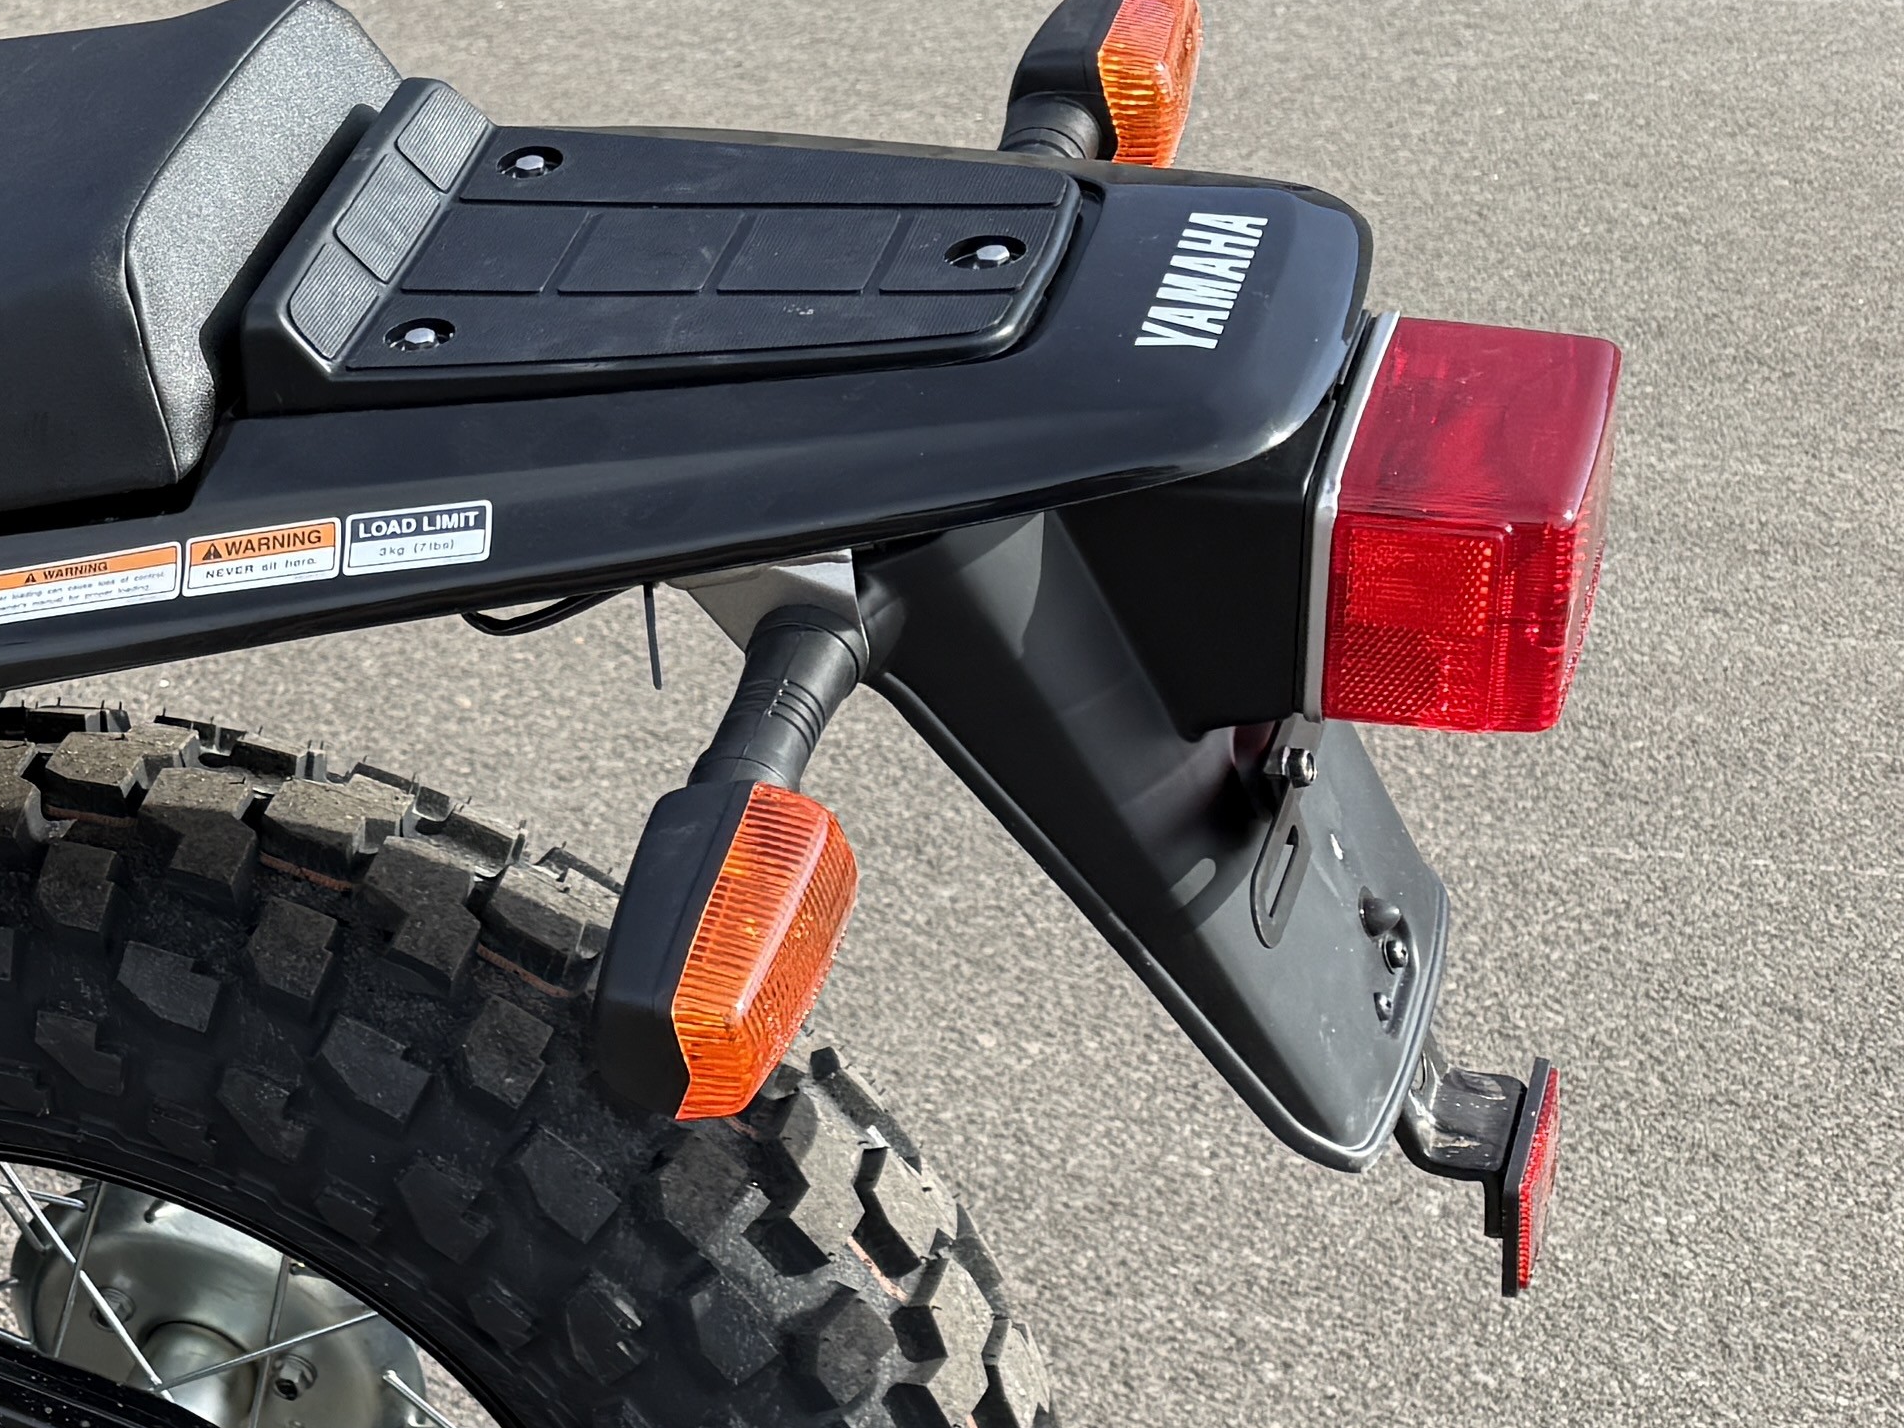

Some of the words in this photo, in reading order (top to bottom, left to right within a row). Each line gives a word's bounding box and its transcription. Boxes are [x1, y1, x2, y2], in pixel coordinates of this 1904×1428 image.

[1134, 212, 1269, 350] YAMAHA
[358, 518, 417, 539] LOAD
[422, 511, 479, 532] LIMIT
[225, 529, 322, 557] WARNING
[42, 561, 108, 581] WARNING
